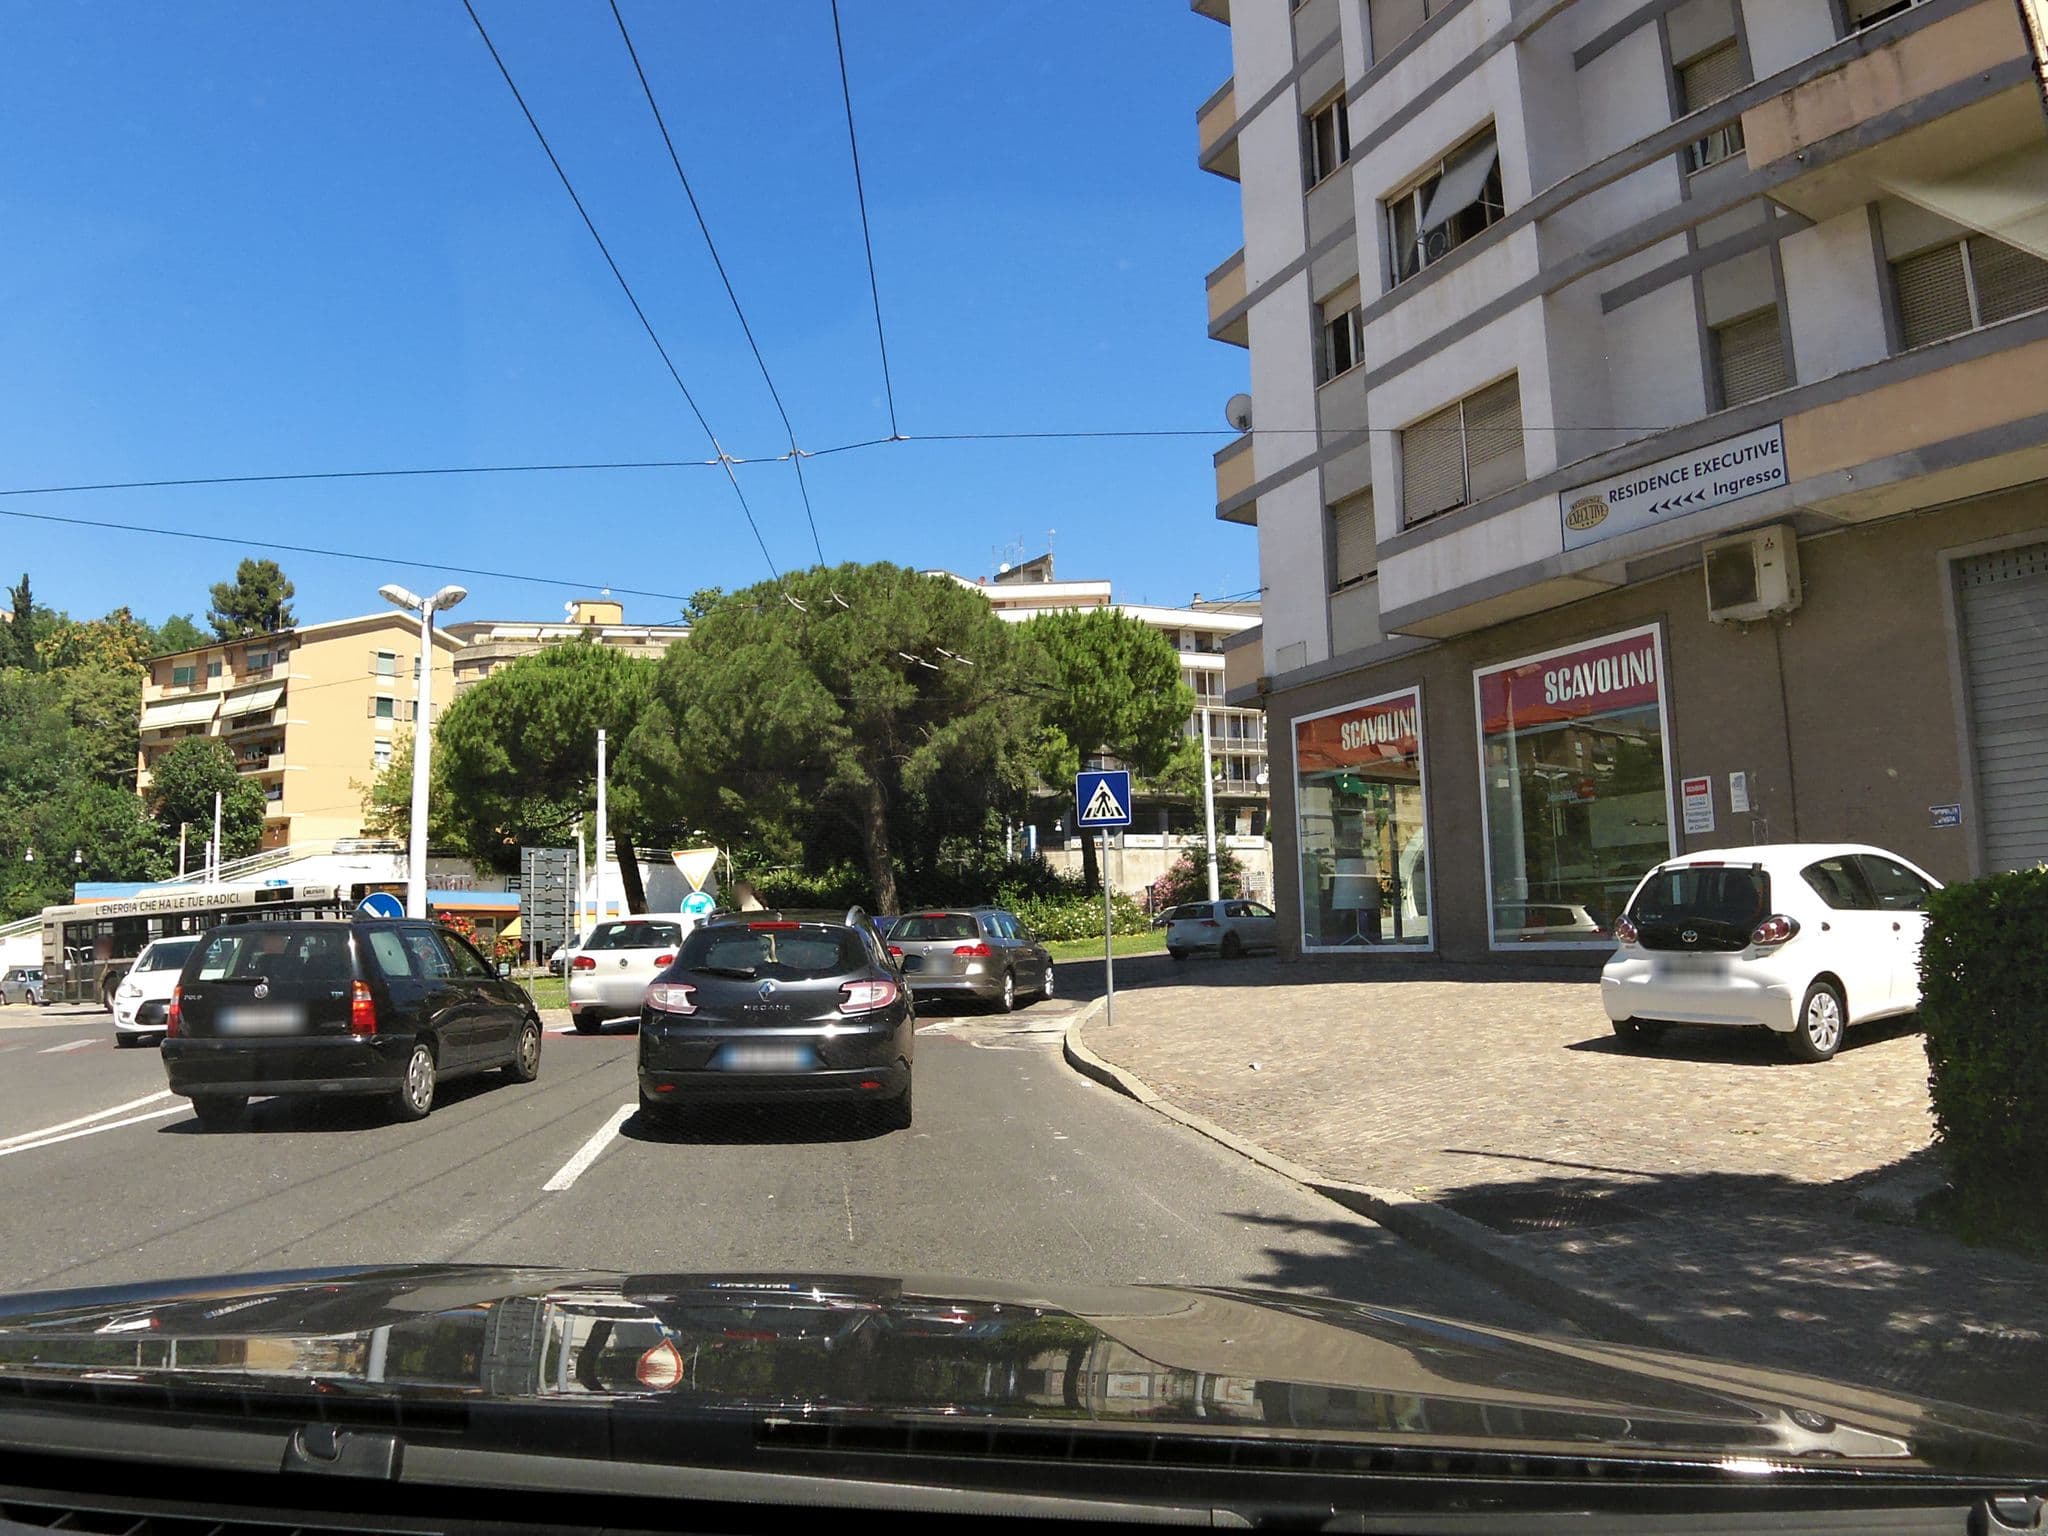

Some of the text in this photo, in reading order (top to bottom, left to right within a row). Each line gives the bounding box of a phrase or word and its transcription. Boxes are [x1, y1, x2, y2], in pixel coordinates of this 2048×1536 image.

[1609, 438, 1780, 503] RESIDENCE EXECUTIVE
[1713, 467, 1782, 496] Ingresso
[1544, 647, 1655, 704] SCAVOLINI
[1341, 706, 1417, 751] SCAVOLINI
[139, 901, 156, 911] CHE
[158, 899, 170, 910] HA
[174, 898, 185, 908] LE
[187, 896, 204, 907] TUE
[207, 893, 241, 905] RADICI.
